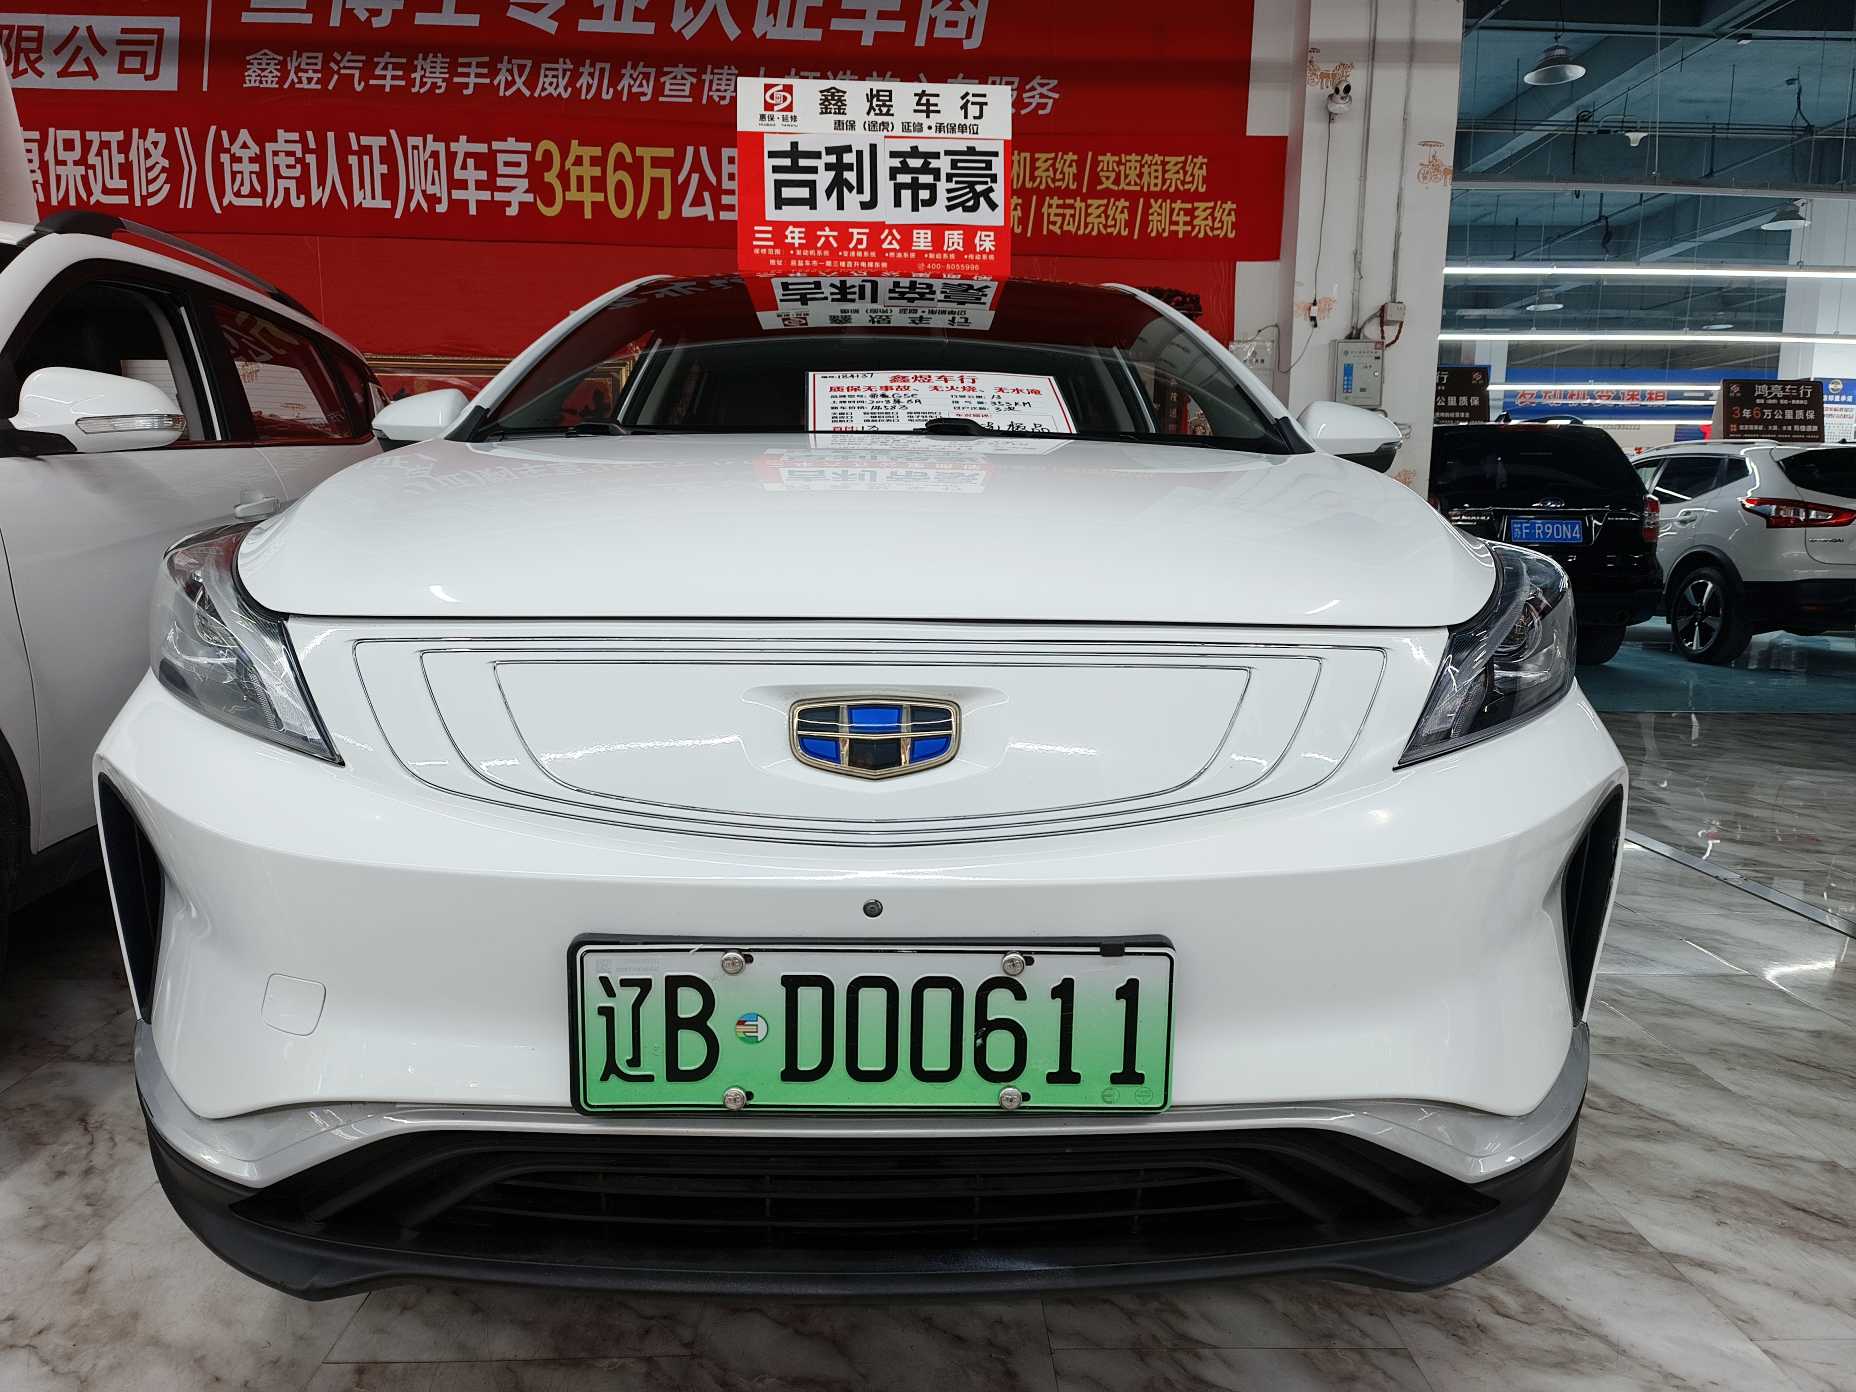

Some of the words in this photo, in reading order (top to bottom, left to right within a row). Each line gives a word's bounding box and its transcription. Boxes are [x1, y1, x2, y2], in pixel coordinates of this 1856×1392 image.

[0, 25, 165, 81] 限公司
[818, 86, 988, 120] 鑫煜车行
[767, 141, 1000, 213] 吉利帝豪
[752, 225, 996, 252] 三年六万公里质保
